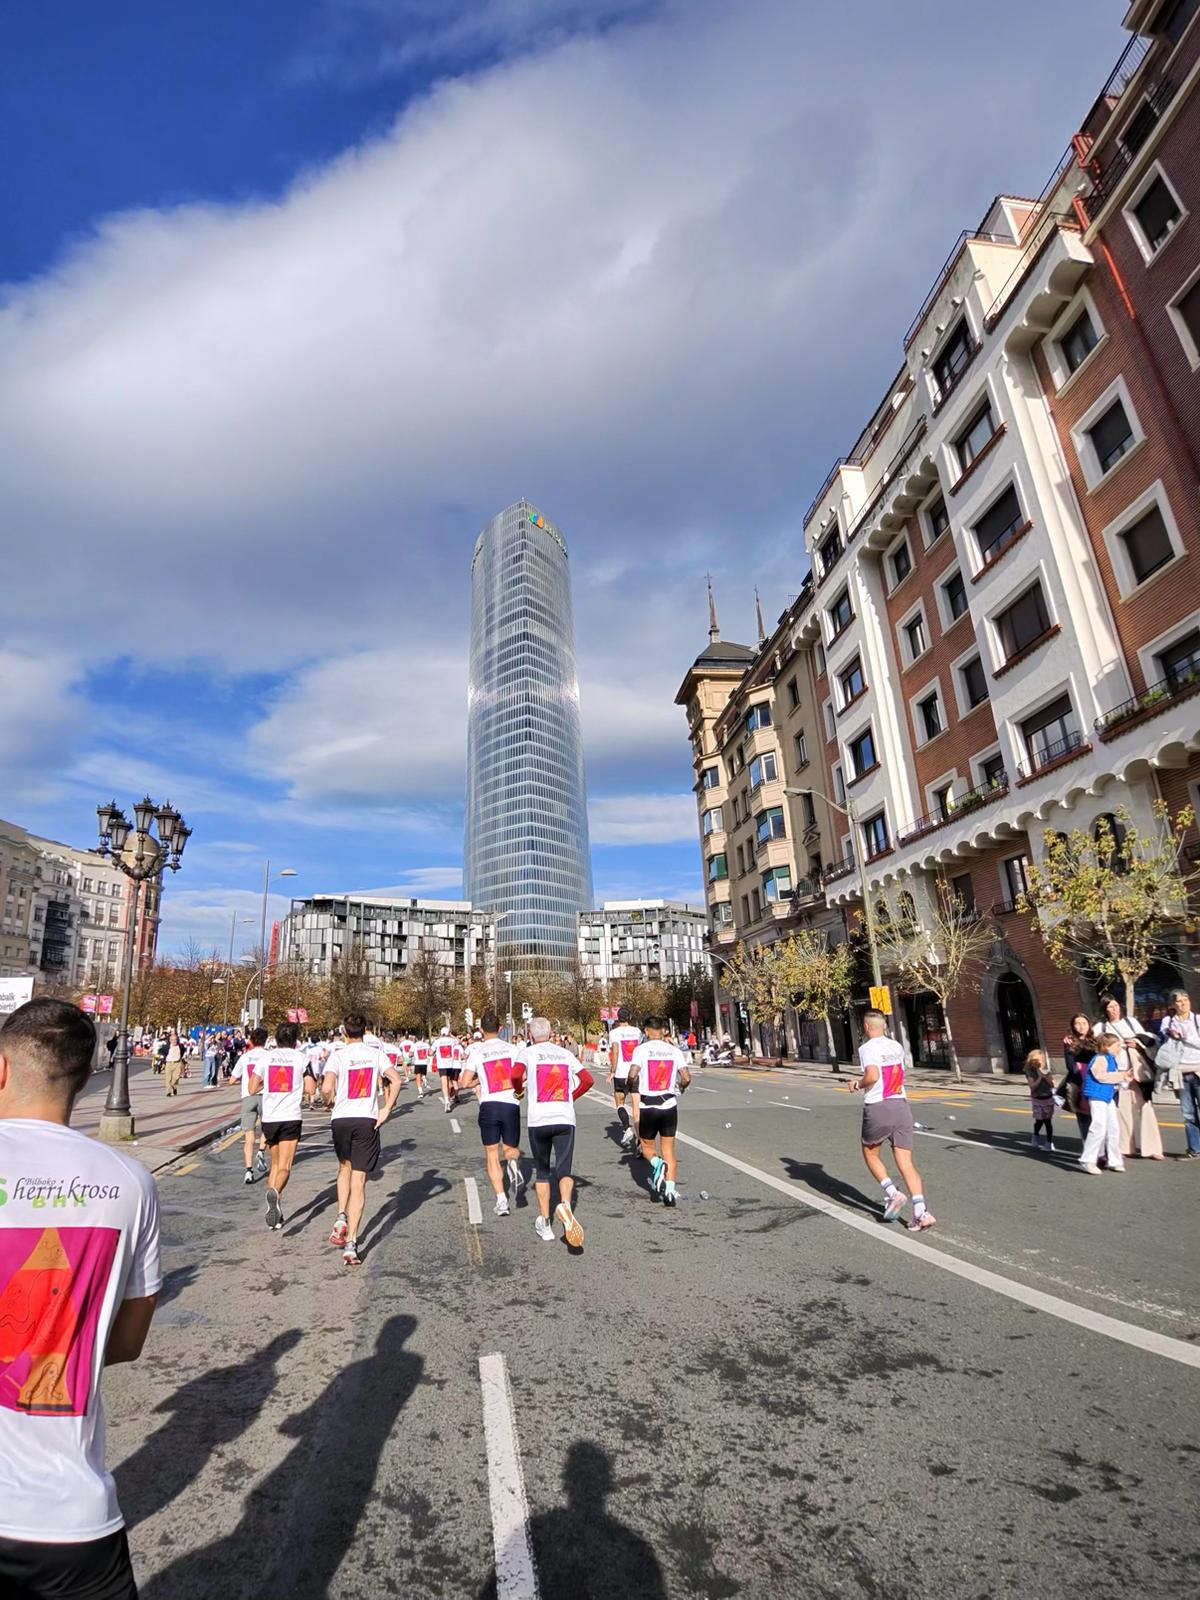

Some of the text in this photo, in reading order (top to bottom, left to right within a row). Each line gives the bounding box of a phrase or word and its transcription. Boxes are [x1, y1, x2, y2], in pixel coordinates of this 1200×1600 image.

[13, 1176, 120, 1203] herri krosa
[24, 1177, 57, 1186] Bilboko
